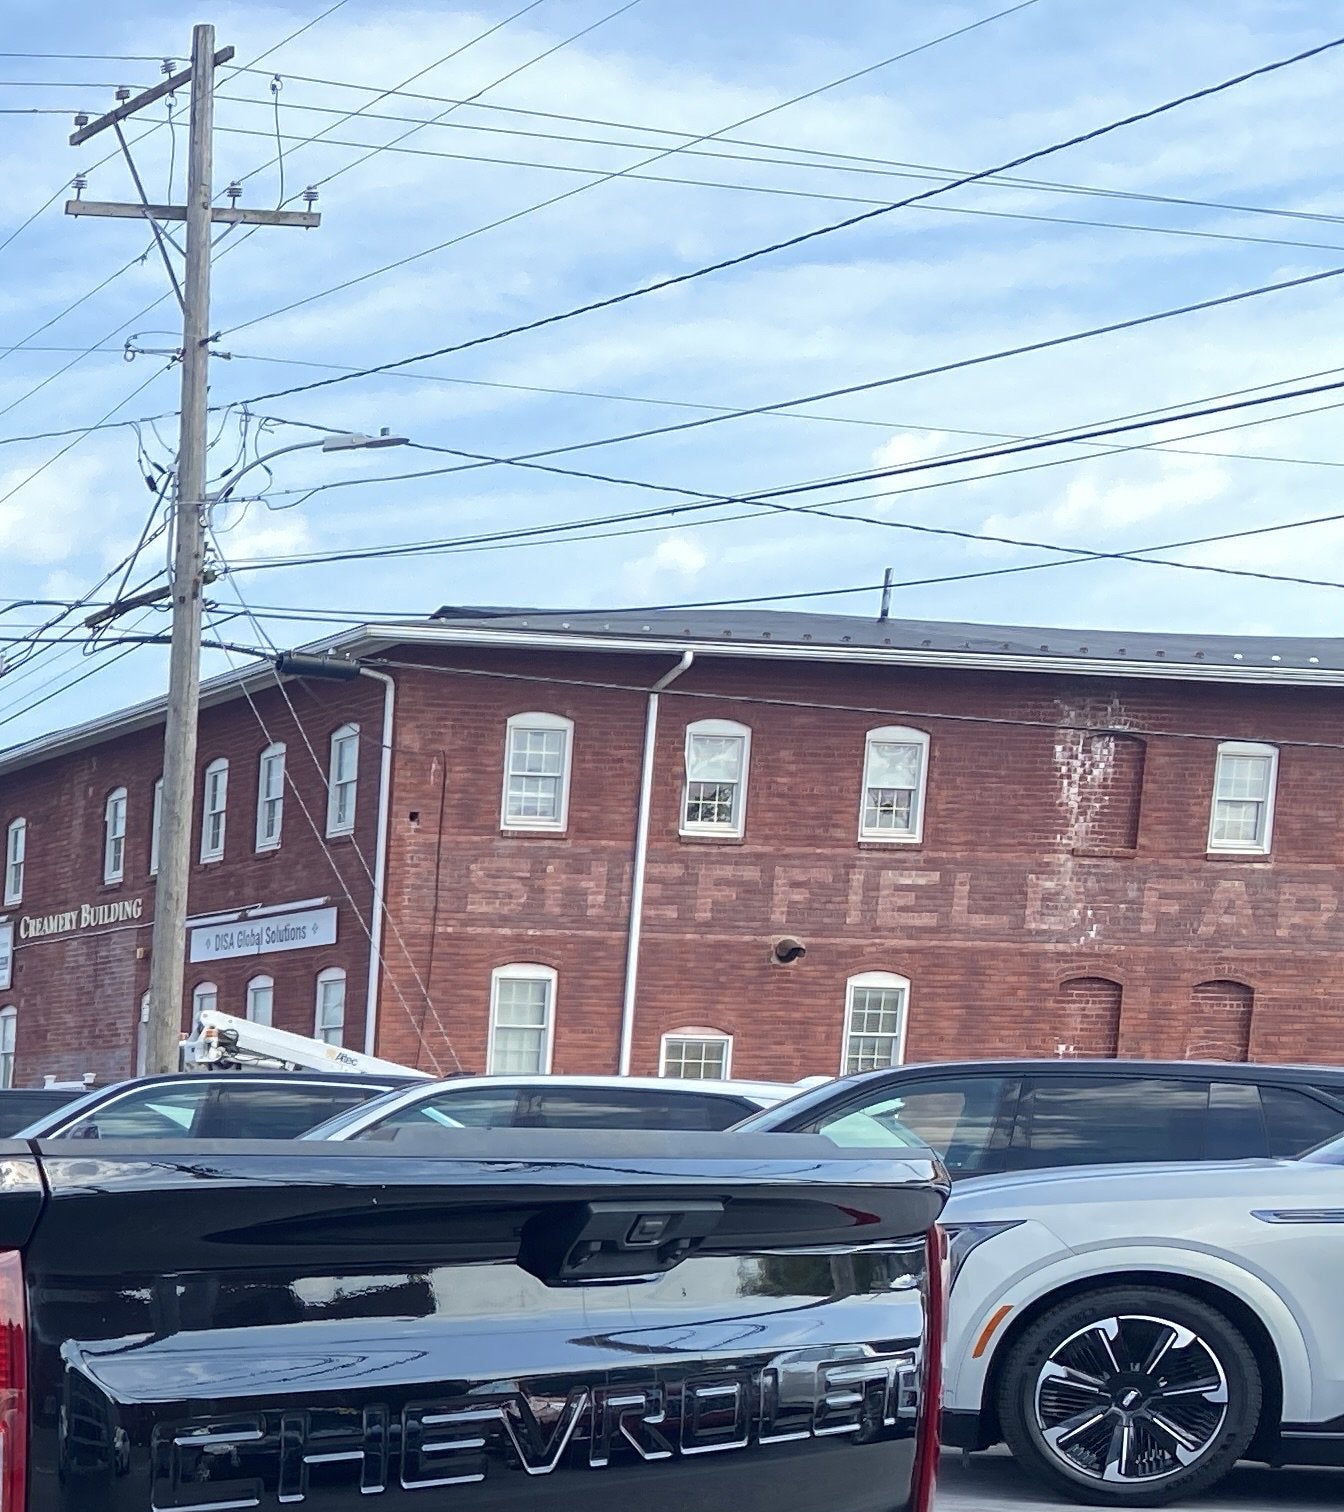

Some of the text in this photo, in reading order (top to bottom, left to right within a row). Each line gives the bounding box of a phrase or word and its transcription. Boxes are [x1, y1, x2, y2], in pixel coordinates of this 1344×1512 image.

[215, 923, 307, 951] DISA Global Solutions
